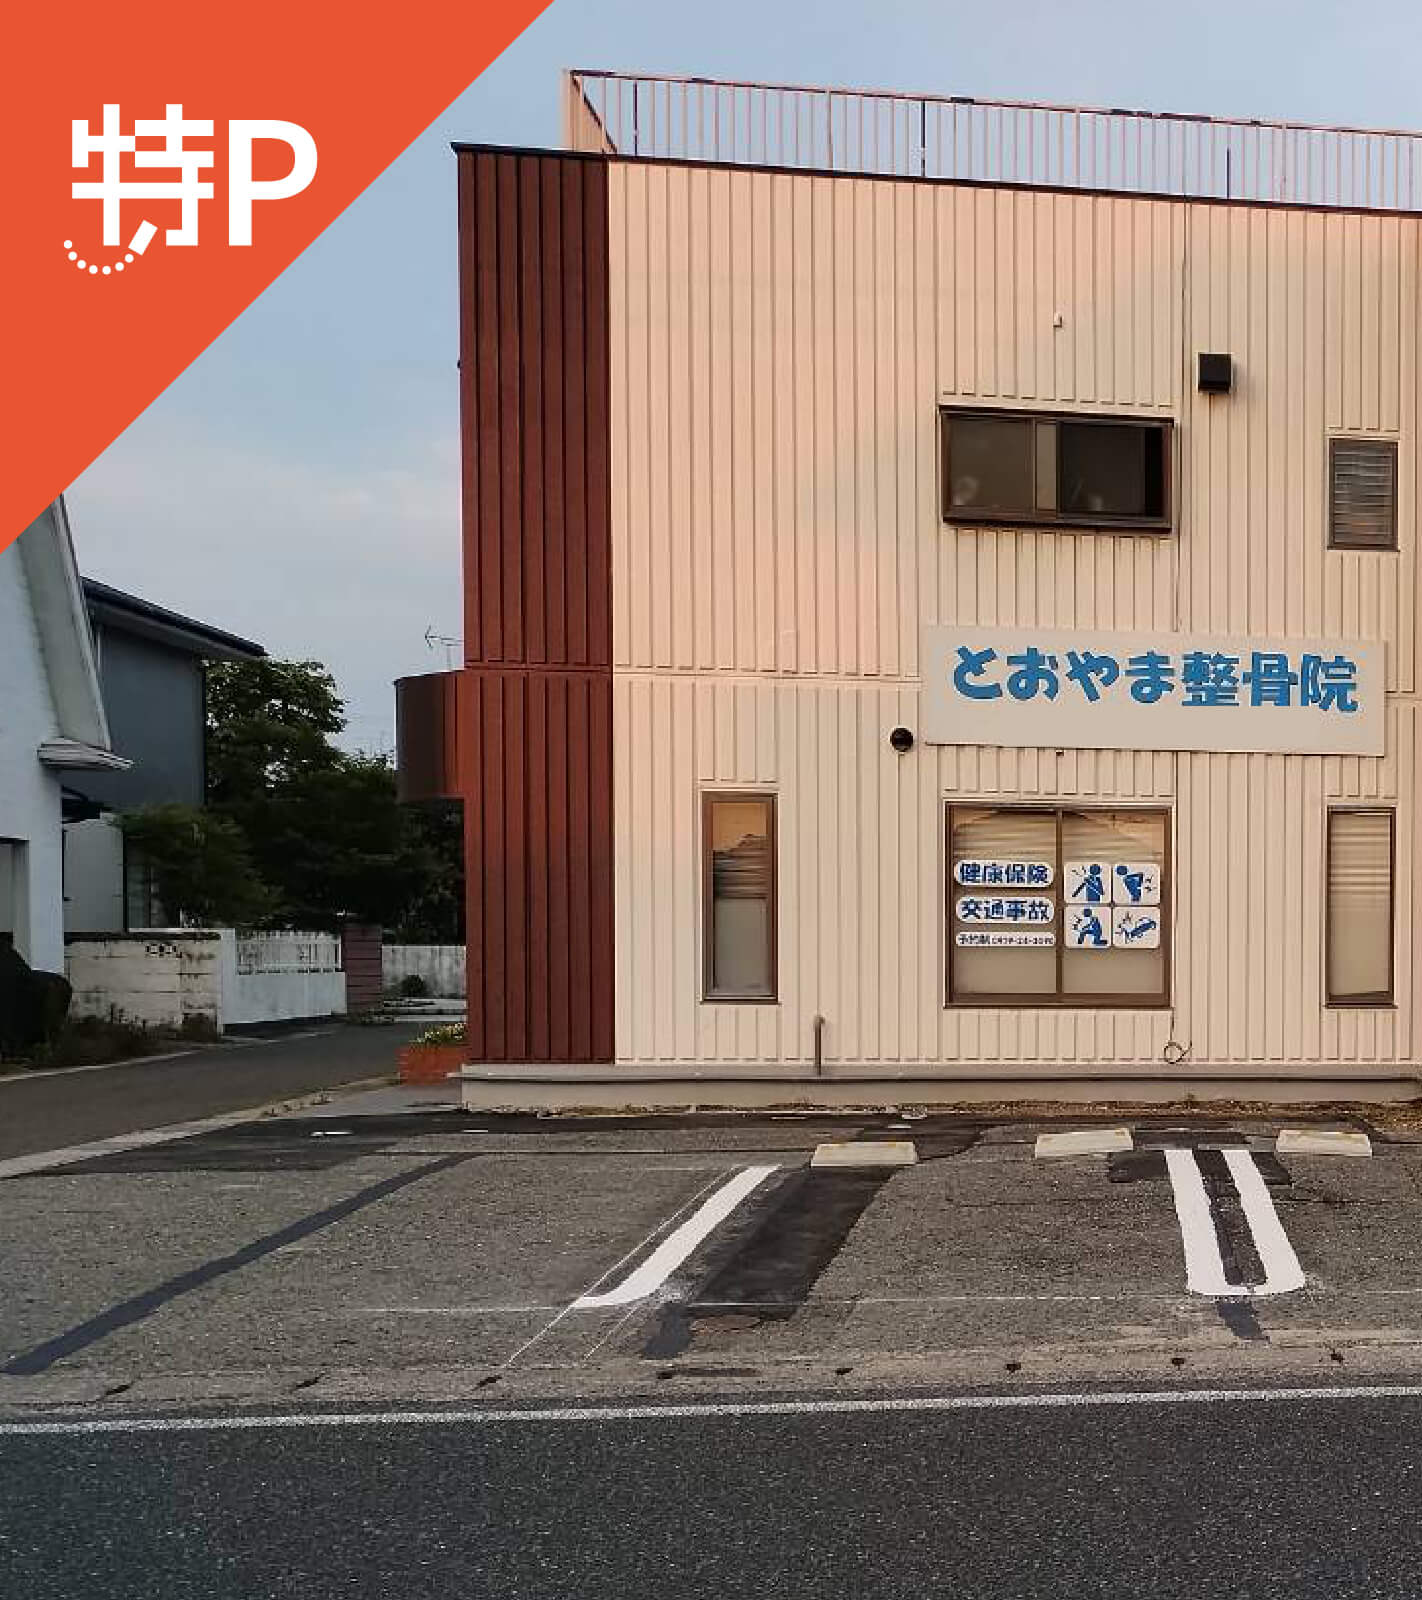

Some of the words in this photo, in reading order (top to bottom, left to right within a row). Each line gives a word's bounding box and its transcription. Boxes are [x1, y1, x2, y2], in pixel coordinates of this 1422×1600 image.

[952, 645, 1359, 712] とおやま整骨院
[960, 862, 1049, 884] 健康保険
[961, 898, 1050, 921] 交通事故
